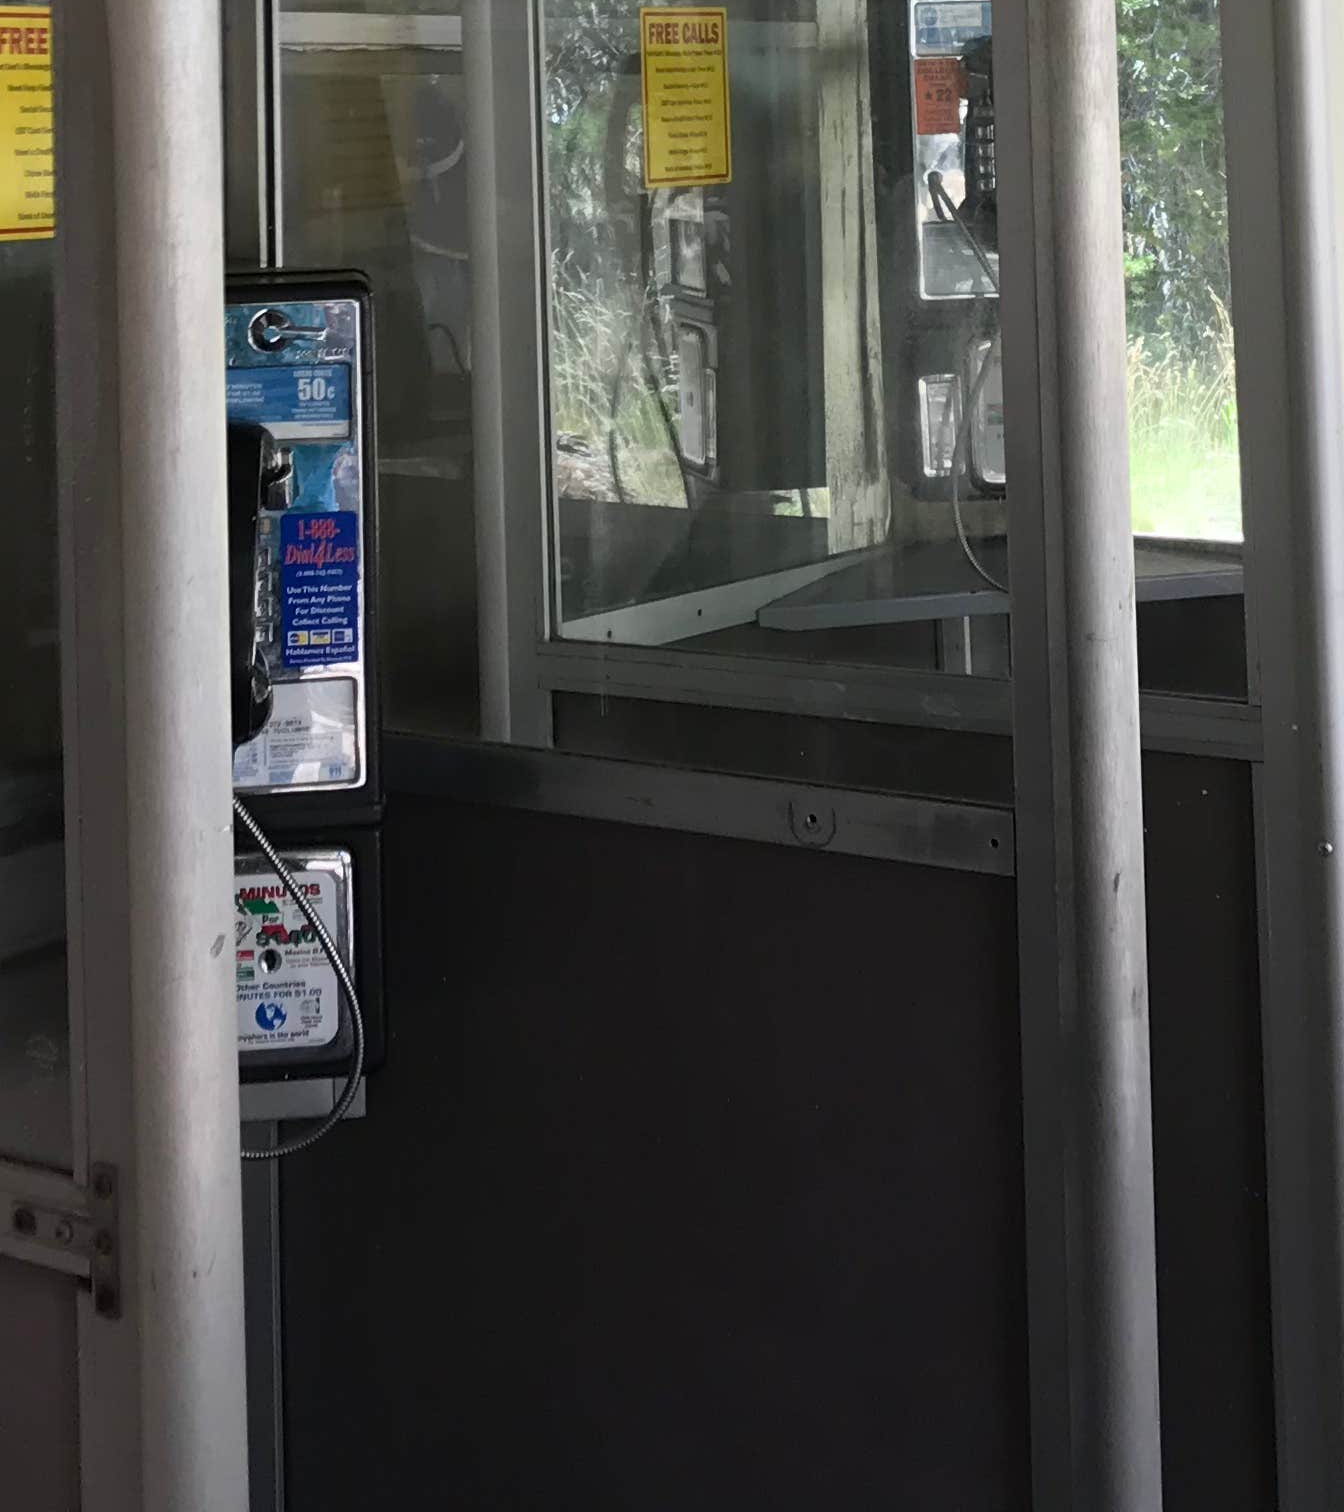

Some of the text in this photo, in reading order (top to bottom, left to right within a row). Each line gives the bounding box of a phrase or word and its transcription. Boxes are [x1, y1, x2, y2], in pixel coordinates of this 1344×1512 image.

[649, 22, 720, 44] FREE CALLS
[320, 584, 353, 592] Number
[288, 594, 352, 604] From Any Phone
[295, 607, 309, 615] For
[292, 616, 348, 626] Collect Calling
[263, 981, 306, 989] Countries
[273, 990, 292, 998] FOR
